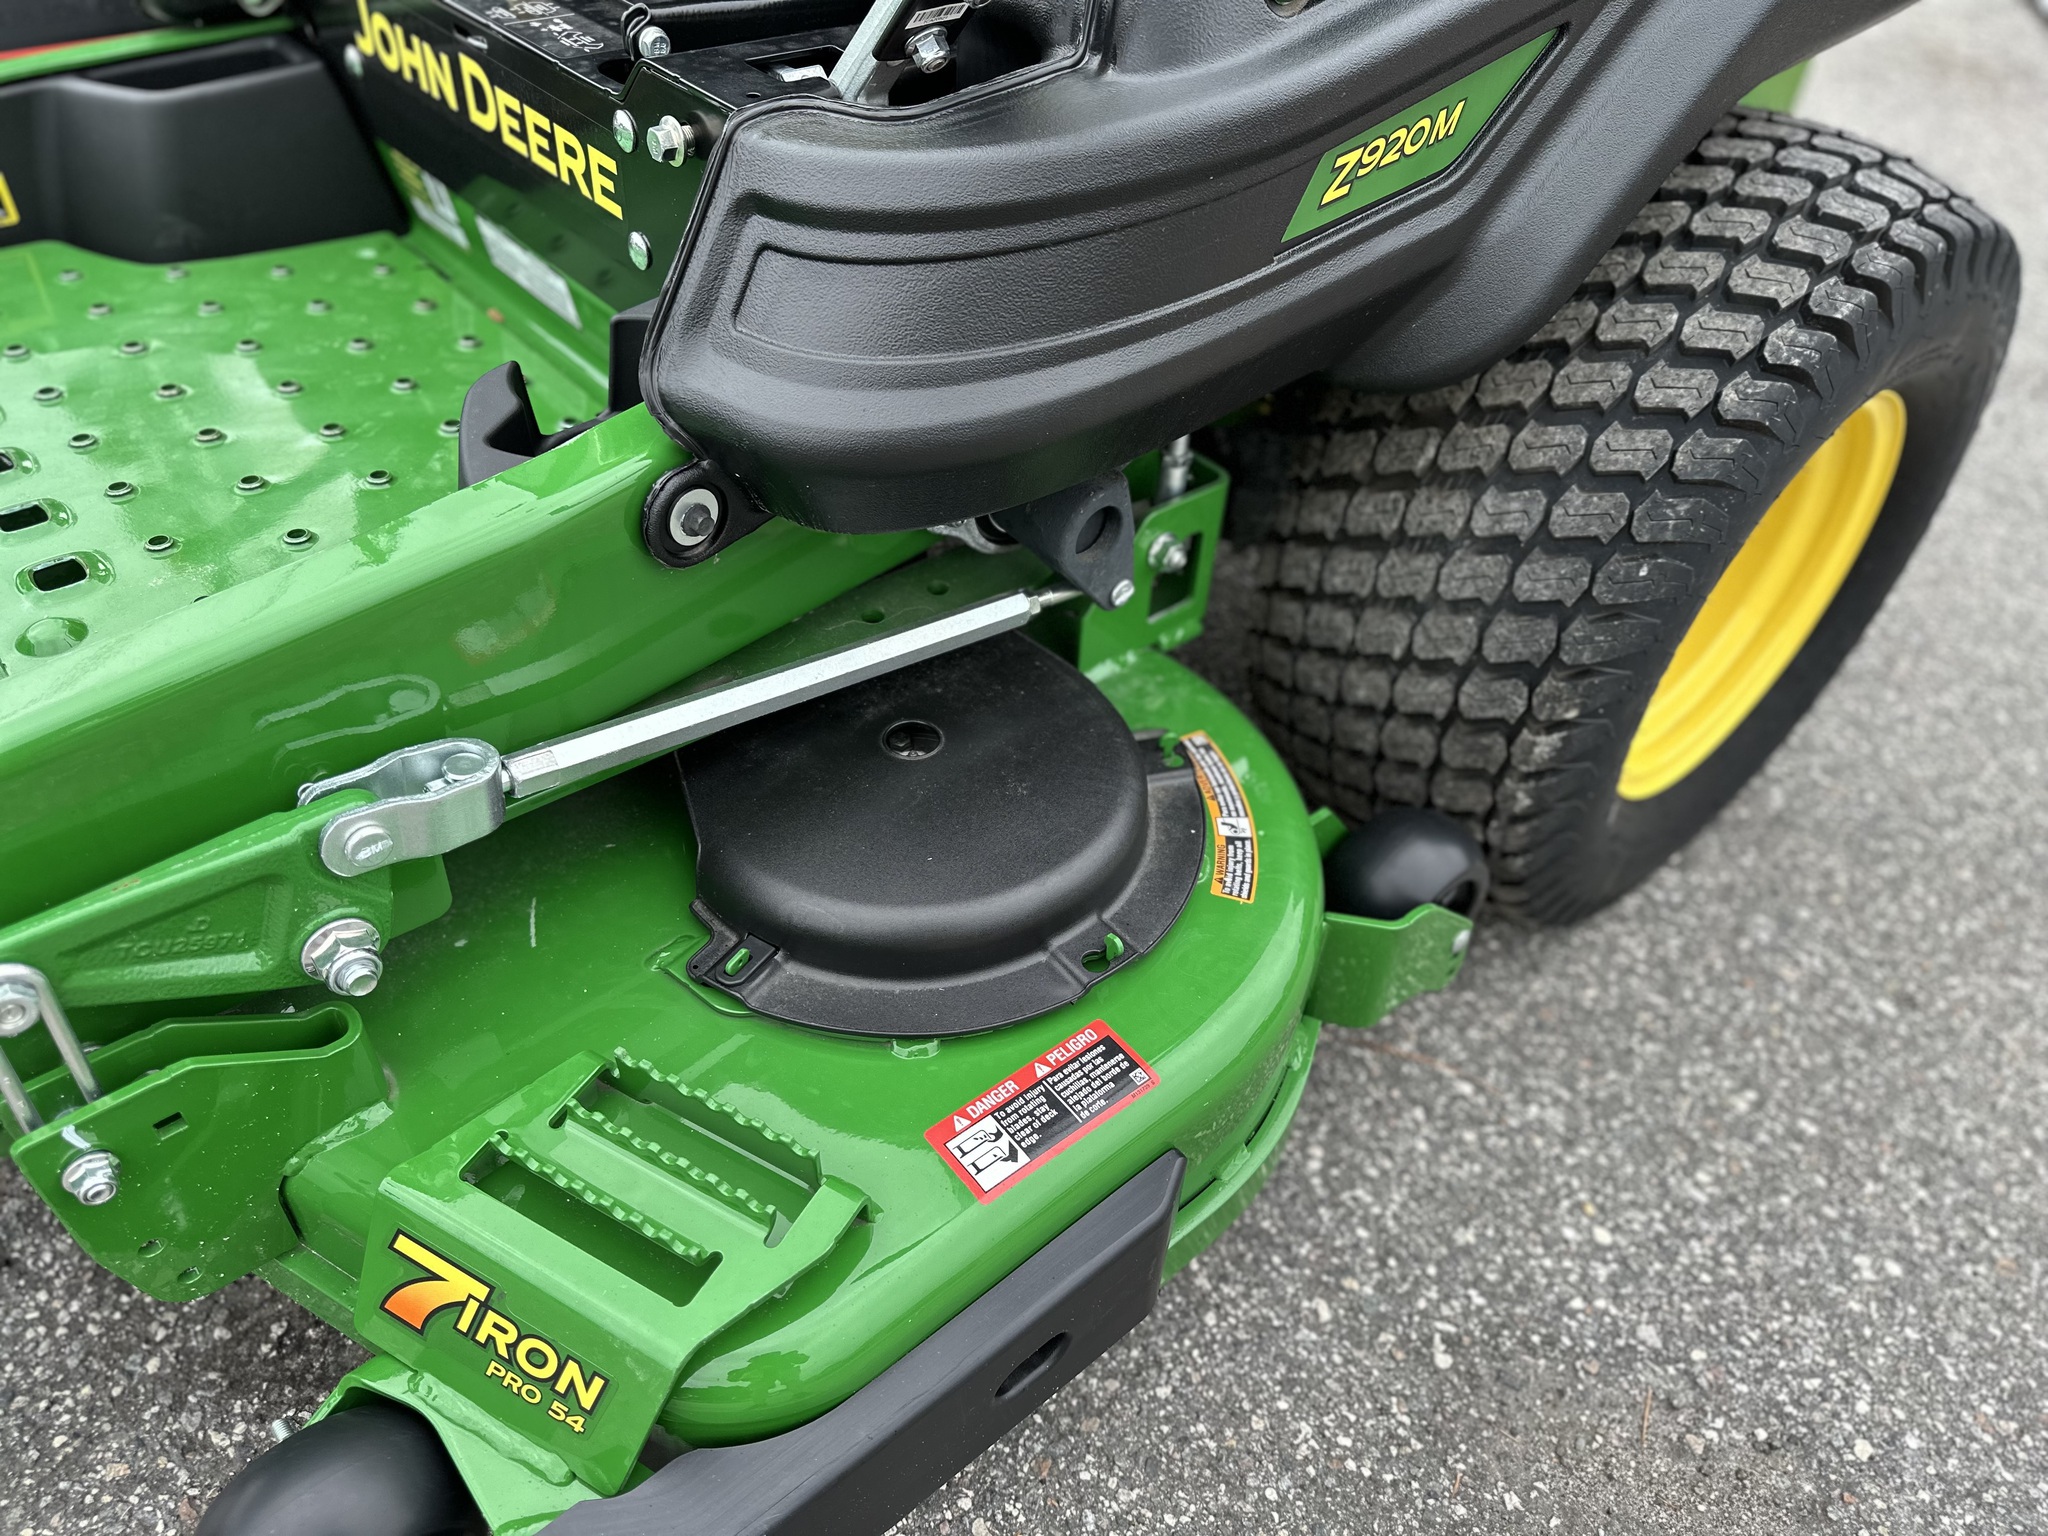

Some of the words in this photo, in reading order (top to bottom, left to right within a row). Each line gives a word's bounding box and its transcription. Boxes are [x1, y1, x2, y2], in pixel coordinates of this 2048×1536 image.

[354, 0, 459, 112] JOHN
[458, 52, 623, 220] DEERE
[1318, 98, 1467, 210] Z920M
[1216, 844, 1226, 876] WARNING
[1045, 1028, 1098, 1066] PELIGRO
[1046, 1072, 1065, 1085] Para
[1063, 1060, 1081, 1075] evitar
[1079, 1044, 1106, 1064] lesiones
[1054, 1069, 1084, 1091] causadas
[1082, 1062, 1094, 1074] por
[1091, 1056, 1105, 1066] las
[1060, 1077, 1092, 1098] cuchillas,
[1089, 1053, 1125, 1079] mantenerse
[1067, 1086, 1092, 1105] alejado
[1090, 1077, 1103, 1089] del
[1100, 1067, 1121, 1082] borde
[1119, 1060, 1130, 1070] de
[966, 1080, 1020, 1119] DANGER
[994, 1111, 1006, 1120] To
[1005, 1097, 1025, 1113] avoid
[1023, 1085, 1045, 1100] injury
[1000, 1113, 1019, 1127] from
[1018, 1095, 1047, 1116] rotating
[1072, 1103, 1083, 1112] la
[1080, 1081, 1115, 1108] plataforma
[1080, 1109, 1090, 1119] de
[1088, 1099, 1109, 1113] corte.
[1006, 1115, 1035, 1134] blades,
[1033, 1103, 1050, 1117] stay
[1014, 1126, 1033, 1141] clear
[1032, 1119, 1042, 1129] of
[1040, 1108, 1059, 1124] deck
[1020, 1133, 1042, 1148] edge.
[485, 1360, 542, 1405] PRO
[547, 1400, 588, 1434] 54
